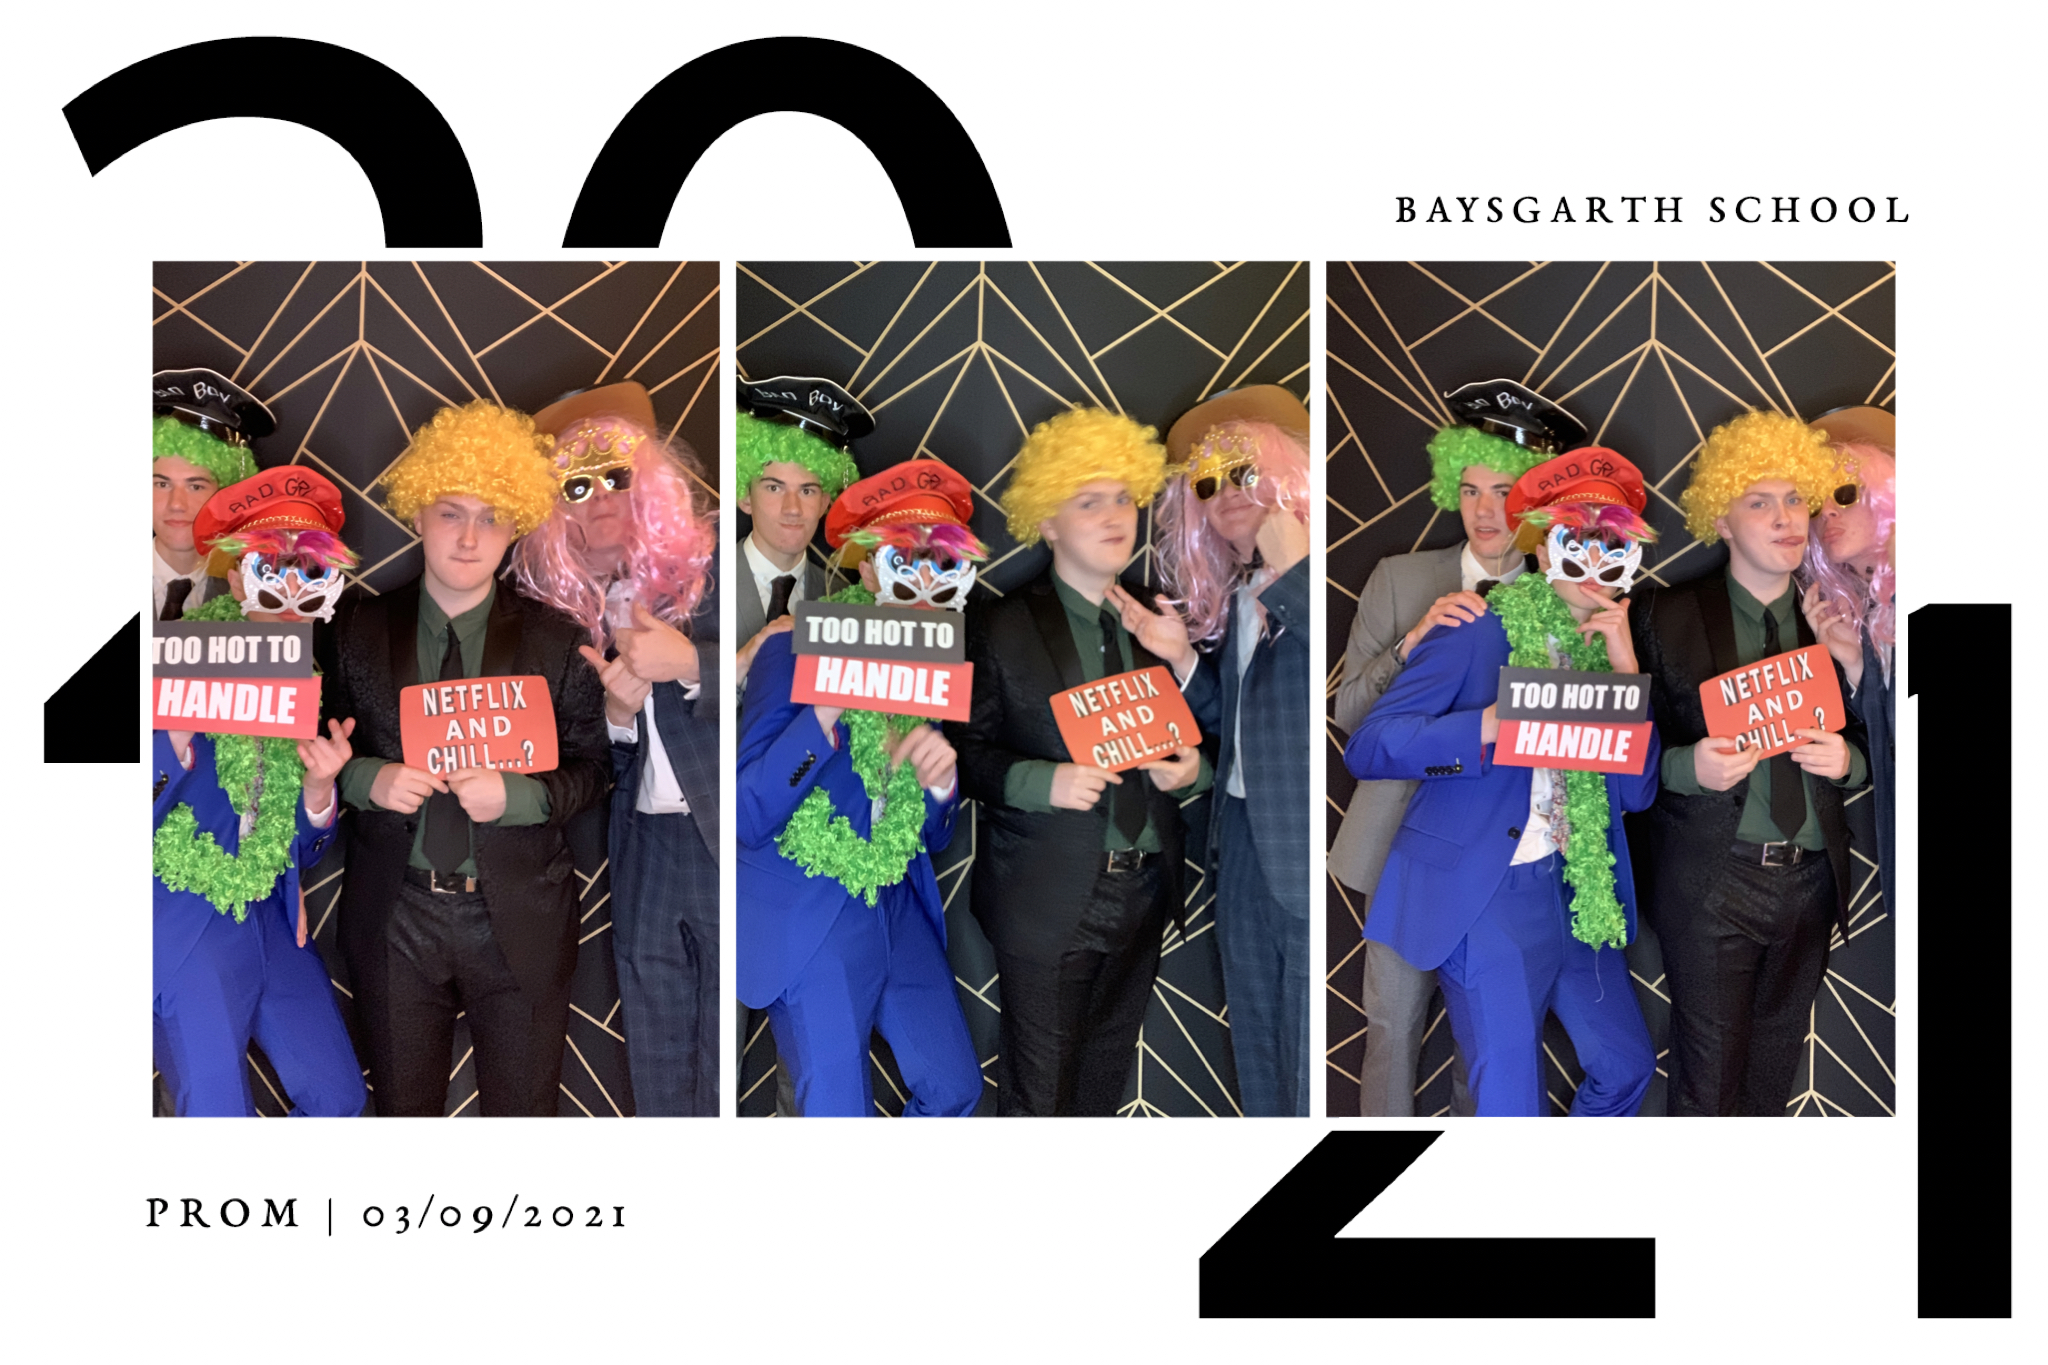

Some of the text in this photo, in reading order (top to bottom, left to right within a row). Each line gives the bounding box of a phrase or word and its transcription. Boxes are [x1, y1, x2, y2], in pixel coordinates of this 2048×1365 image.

[152, 635, 302, 665] TOO HOT TO
[805, 615, 954, 649] TOO HOT TO
[814, 655, 951, 707] HANDLE
[1068, 672, 1160, 719] NETFLIX
[1510, 682, 1641, 711] TOO HOT TO
[1719, 652, 1814, 707] NETFLIX
[156, 678, 298, 725] HANDLE
[422, 680, 528, 717] NETFLIX
[1748, 689, 1805, 725] AND
[445, 715, 513, 741] AND
[1101, 705, 1155, 737] AND
[426, 739, 535, 775] CHILL...?
[1092, 721, 1183, 769] CHILL...?
[1514, 720, 1633, 763] HANDLE
